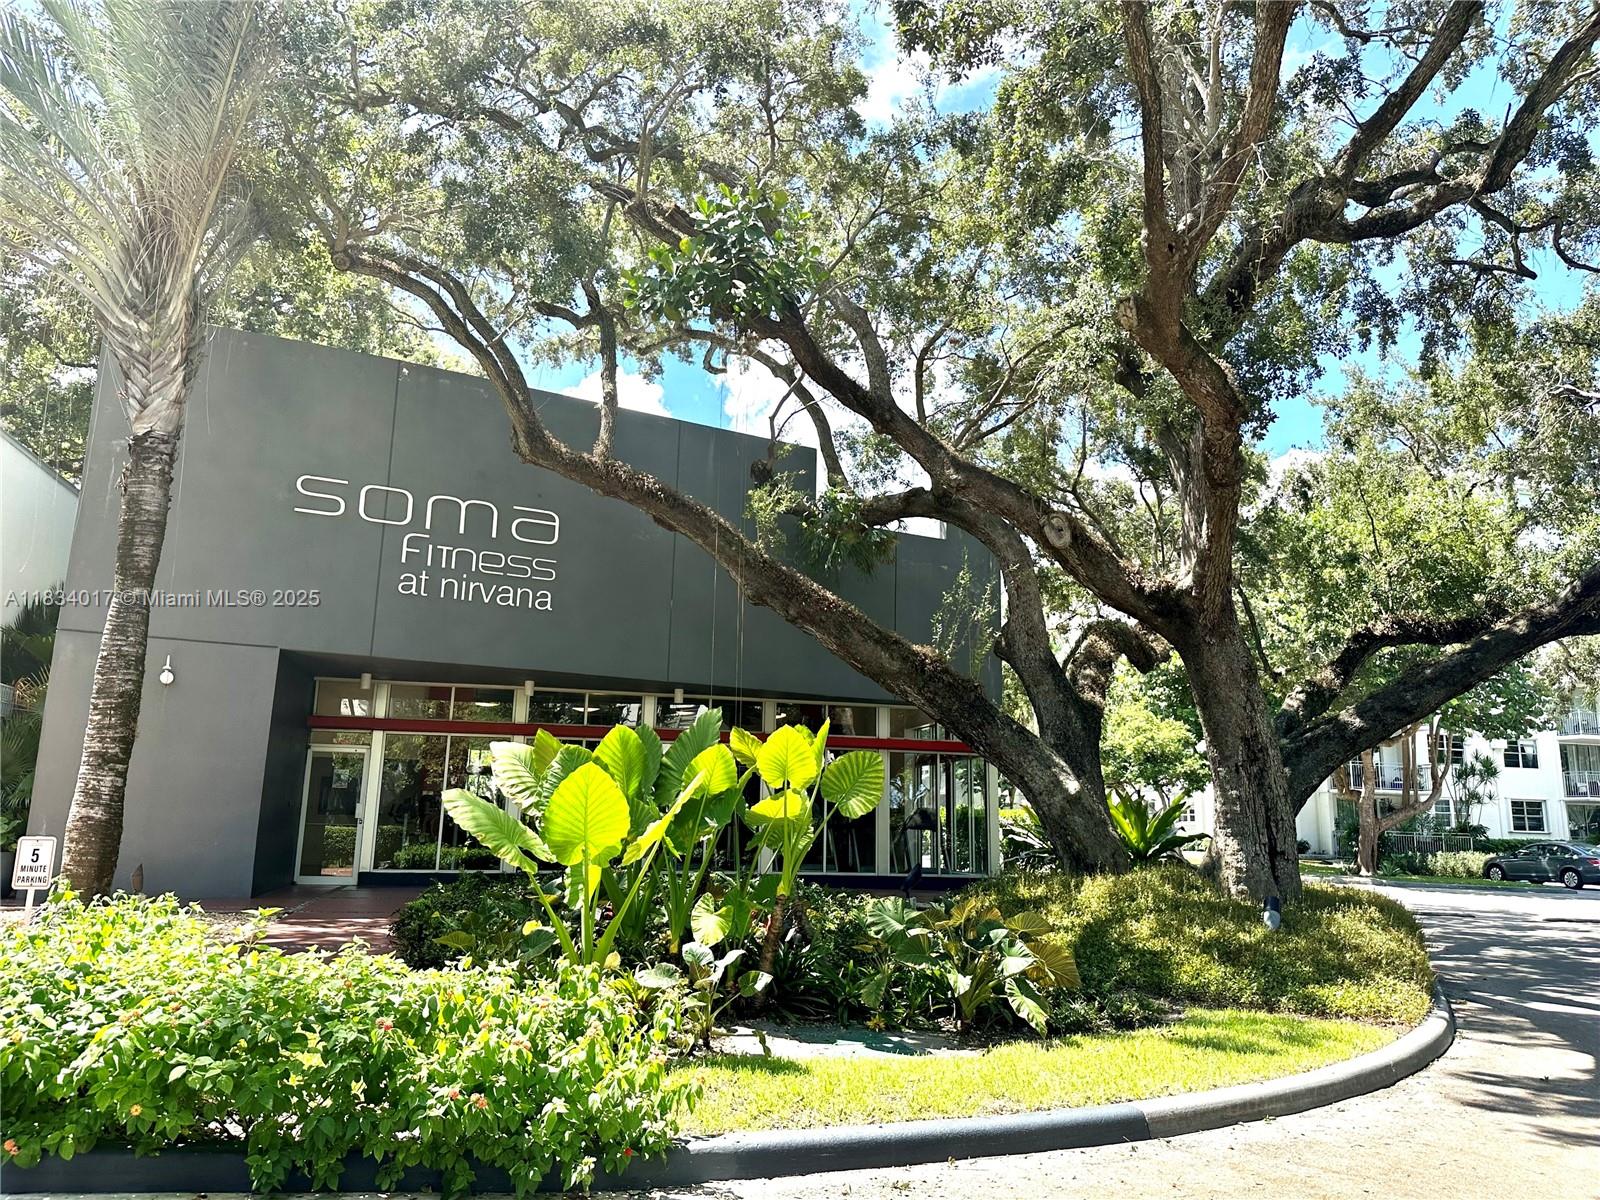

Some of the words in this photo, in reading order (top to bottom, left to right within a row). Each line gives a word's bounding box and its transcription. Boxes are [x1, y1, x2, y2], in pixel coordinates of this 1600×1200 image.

[293, 474, 560, 545] soma
[397, 570, 429, 597] at
[440, 573, 553, 611] nirvana
[31, 848, 40, 863] 5
[20, 865, 47, 873] MINUTE
[16, 876, 48, 884] PARKING
